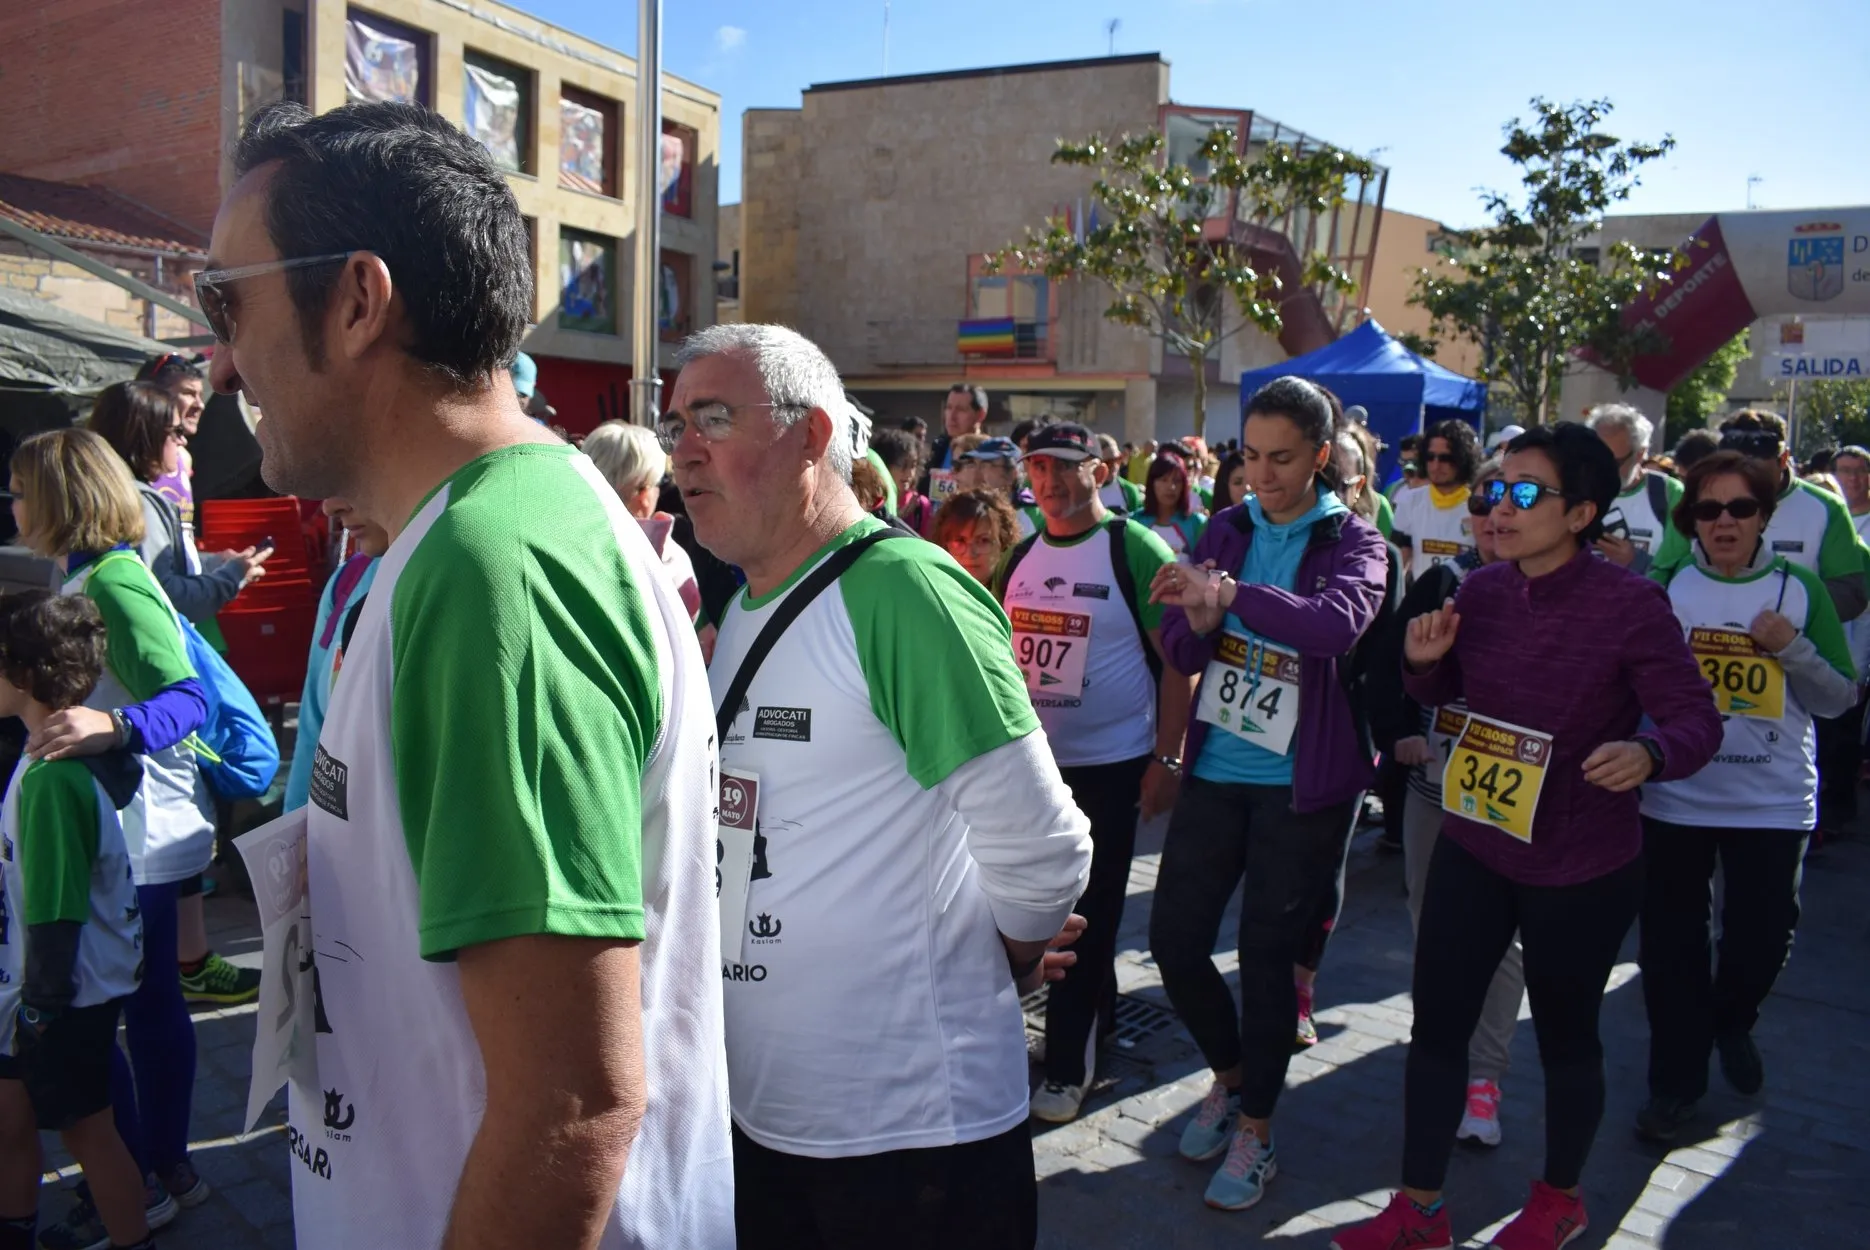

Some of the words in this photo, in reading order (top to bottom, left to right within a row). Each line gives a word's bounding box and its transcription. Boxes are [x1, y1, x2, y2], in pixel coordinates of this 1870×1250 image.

[1654, 252, 1727, 319] DEPORTE
[1781, 358, 1862, 376] SALIDA
[1031, 613, 1065, 626] CROSS
[1694, 631, 1711, 641] VII
[1020, 636, 1072, 670] 907
[1702, 658, 1767, 695] 360
[1219, 670, 1283, 720] 874
[758, 709, 807, 721] ADVOCATI
[763, 719, 795, 727] ABOGADOS
[1480, 727, 1517, 746] CROSS
[1525, 740, 1541, 754] 19
[1460, 755, 1523, 808] 342
[722, 787, 742, 806] 19
[722, 809, 741, 820] MAYO
[722, 964, 767, 982] ARIO
